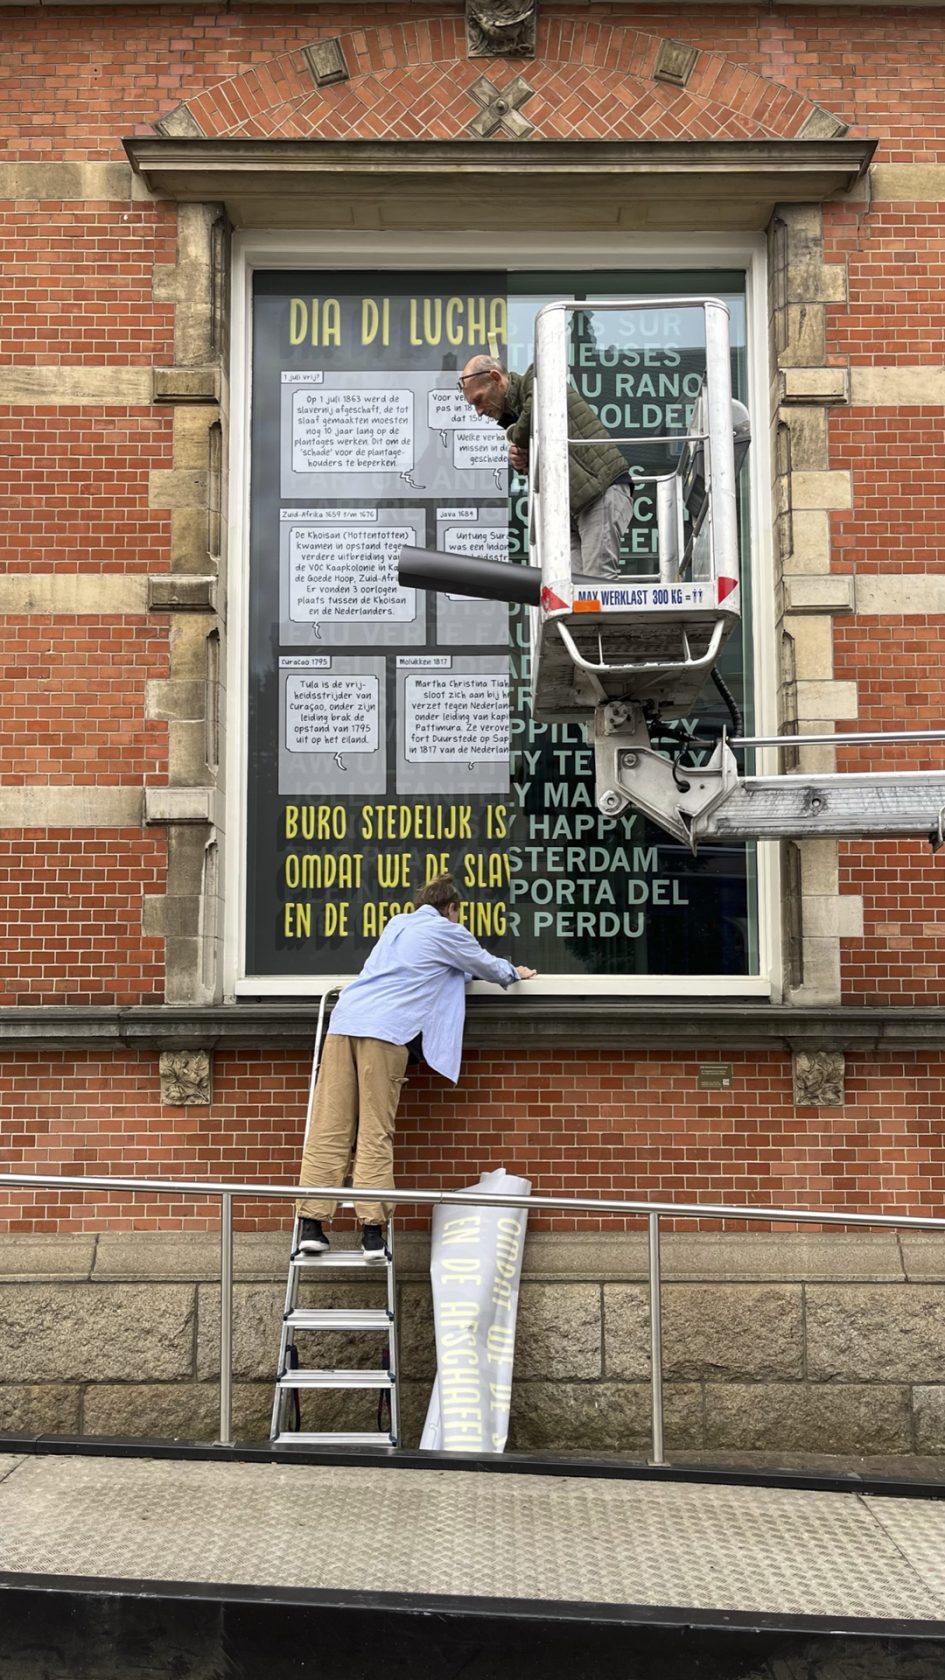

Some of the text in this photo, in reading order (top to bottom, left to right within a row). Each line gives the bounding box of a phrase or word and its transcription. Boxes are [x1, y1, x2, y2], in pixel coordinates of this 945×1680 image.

[290, 297, 507, 346] DIA DI LUCHA
[618, 313, 681, 337] SUR
[615, 373, 702, 398] RANO
[307, 395, 316, 404] Op
[326, 396, 340, 404] juli
[343, 395, 361, 403] 1863
[364, 395, 386, 403] werd
[389, 395, 399, 403] de
[297, 406, 333, 415] slavernij
[336, 405, 381, 416] afgeschaft,
[298, 416, 319, 424] slaaf
[323, 416, 368, 427] gemaakten
[306, 428, 321, 437] nog
[335, 428, 353, 437] jaar
[357, 428, 373, 437] lang
[377, 429, 386, 437] op
[295, 438, 334, 448] plantages
[401, 437, 411, 445] de
[459, 444, 488, 452] missen
[356, 448, 366, 456] de
[368, 448, 405, 459] plantage-
[308, 459, 342, 467] houders
[295, 531, 408, 539] De Khoisan (Hottentotten)
[457, 533, 487, 543] Untung
[346, 542, 380, 551] opstand
[338, 553, 384, 563] uitbreiding
[326, 564, 375, 572] Kaapkolonie
[307, 574, 332, 582] Goede
[335, 575, 356, 583] Hoop,
[361, 586, 397, 596] oorlogen
[297, 597, 325, 605] plaats
[601, 590, 647, 605] WERKLAST
[653, 589, 668, 604] 300
[671, 589, 682, 603] KG
[322, 607, 332, 615] de
[346, 681, 366, 690] vrij-
[294, 692, 352, 701] heidsstrijder
[424, 691, 445, 699] sloot
[487, 691, 499, 700] bij
[358, 704, 375, 712] zijn
[412, 702, 441, 710] verzet
[445, 702, 468, 712] tegen
[301, 714, 328, 724] leiding
[443, 713, 470, 724] leiding
[294, 725, 330, 734] opstand
[352, 724, 371, 732] 1795
[312, 737, 321, 745] op
[411, 733, 429, 742] fort
[432, 734, 477, 742] Duurstede
[480, 736, 489, 744] op
[285, 805, 507, 839] BURO STEDELIJK IS
[529, 815, 637, 840] HAPPY
[285, 854, 363, 888] OMDAT
[378, 854, 411, 888] WE
[426, 853, 449, 883] DE
[509, 880, 689, 905] PORTA DEL
[284, 902, 311, 937] EN
[324, 902, 349, 936] DE
[534, 912, 645, 938] PERDU
[442, 1216, 481, 1245] EN
[491, 1217, 521, 1310] OMDAT
[442, 1258, 481, 1285] DE
